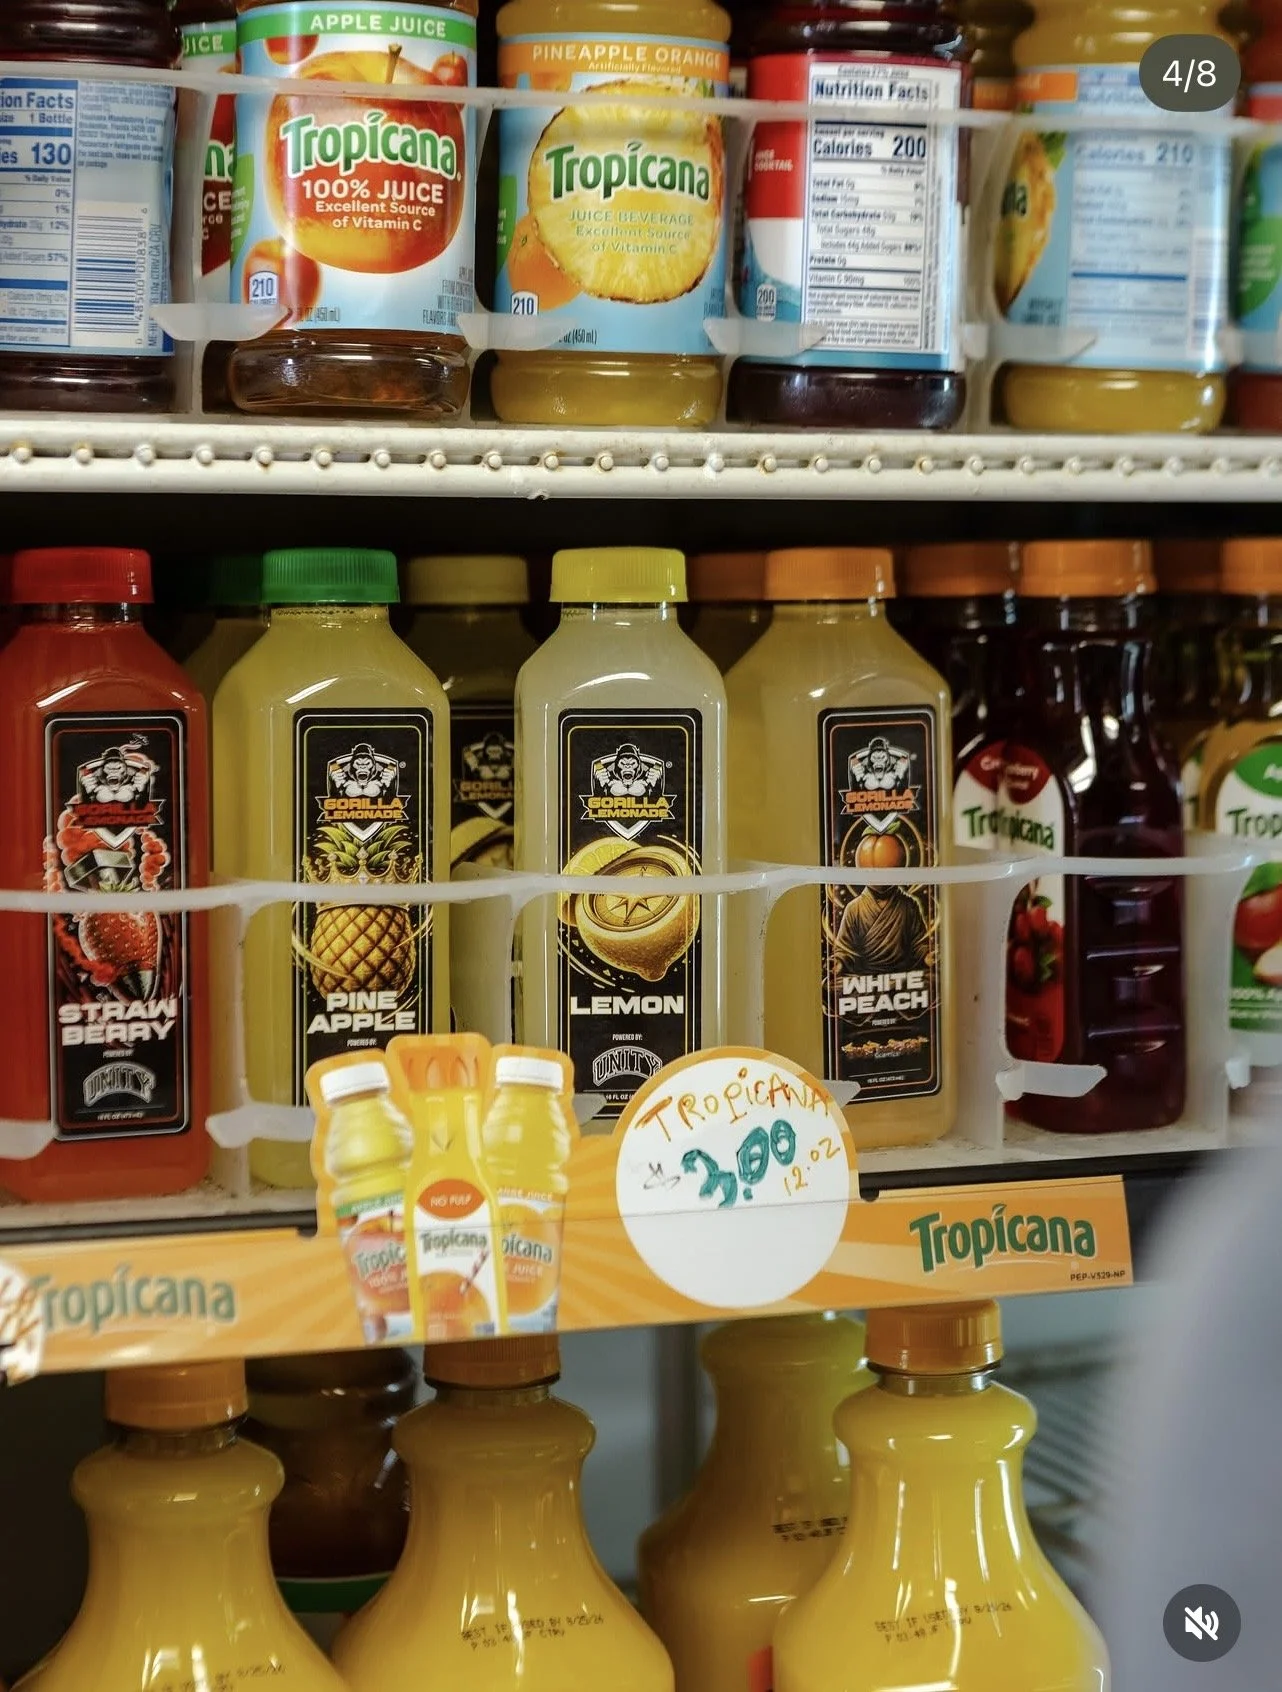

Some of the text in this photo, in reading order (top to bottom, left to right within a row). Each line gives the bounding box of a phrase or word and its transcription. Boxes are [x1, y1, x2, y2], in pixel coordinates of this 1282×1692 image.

[311, 14, 446, 37] APPLE JUICE
[533, 45, 647, 62] PINEAPPLE
[26, 91, 74, 109] Facts
[815, 80, 928, 100] Nutrition Facts
[38, 112, 73, 124] Bottle
[283, 110, 457, 177] Tropicana
[814, 135, 927, 158] Calories 200
[1157, 142, 1192, 163] 210
[31, 142, 72, 166] 130
[545, 142, 710, 200] Tropicana
[302, 179, 444, 204] 100% JUICE
[315, 200, 436, 217] Excellent Source
[570, 209, 694, 227] JUICE BEVERAGE
[333, 216, 423, 232] of Vitamin C
[576, 225, 691, 240] Excellent Source
[592, 243, 606, 252] of
[610, 243, 665, 255] Vitamin
[252, 277, 275, 298] 210
[513, 296, 535, 315] 210
[324, 797, 402, 810] GORILLA
[588, 797, 670, 809] GORILLA
[845, 789, 914, 803] GORILLA
[325, 809, 402, 820] LEMONADE
[589, 809, 669, 818] LEMONADE
[846, 800, 914, 813] LEMONADE
[842, 970, 925, 995] WHITE
[58, 998, 178, 1024] STRAW
[326, 990, 398, 1012] PINE
[570, 995, 684, 1015] LEMON
[838, 990, 929, 1016] PEACH
[307, 1010, 416, 1034] APPLE
[61, 1020, 176, 1047] BERRY
[346, 1039, 369, 1047] POWERED
[612, 1033, 643, 1041] POWERED BY:
[593, 1046, 662, 1087] UNITY
[83, 1062, 155, 1107] UNITY
[681, 1119, 796, 1208] 3.00
[430, 1195, 447, 1208] NO
[421, 1228, 488, 1254] Tropicana
[912, 1203, 1097, 1273] Tropicana
